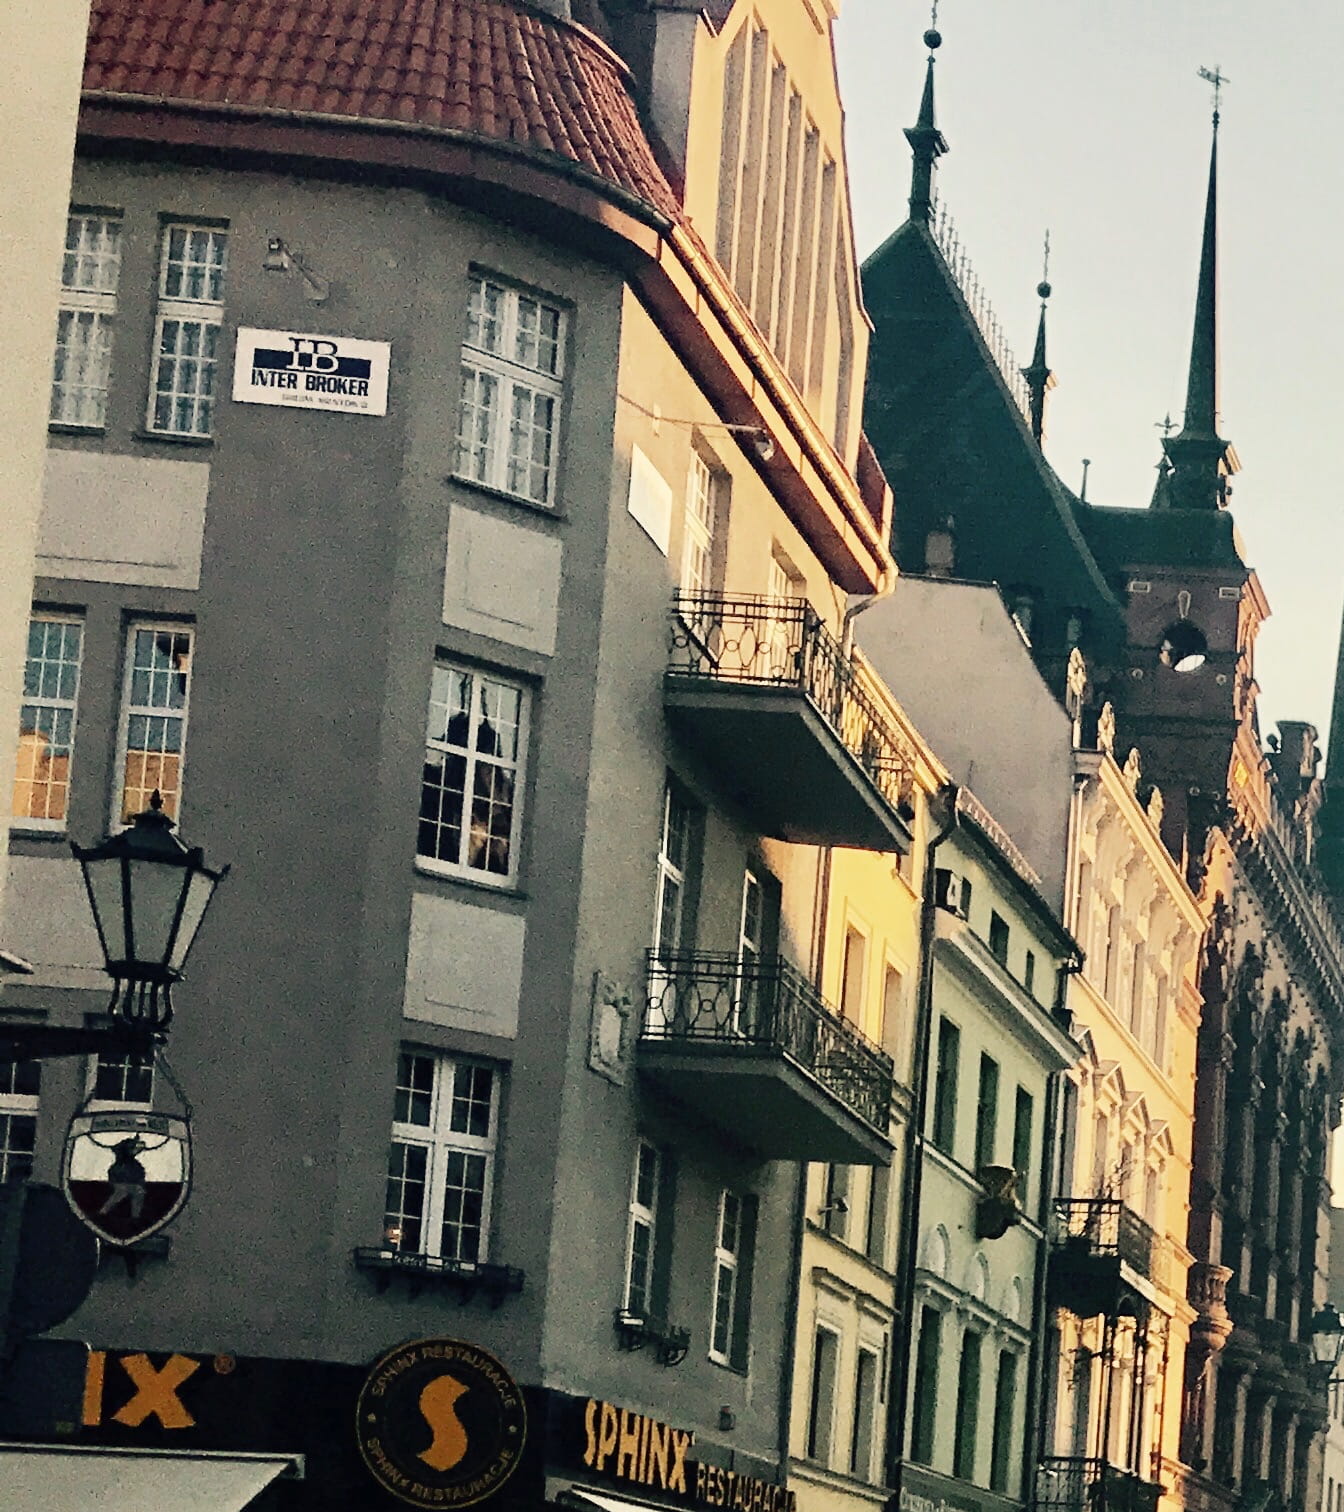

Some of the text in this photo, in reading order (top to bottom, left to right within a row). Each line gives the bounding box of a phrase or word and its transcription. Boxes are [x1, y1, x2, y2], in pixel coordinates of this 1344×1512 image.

[286, 337, 340, 373] IB
[251, 368, 369, 396] INTER BROKER
[371, 1351, 418, 1397] SPHINX
[583, 1398, 691, 1494] SPHINX
